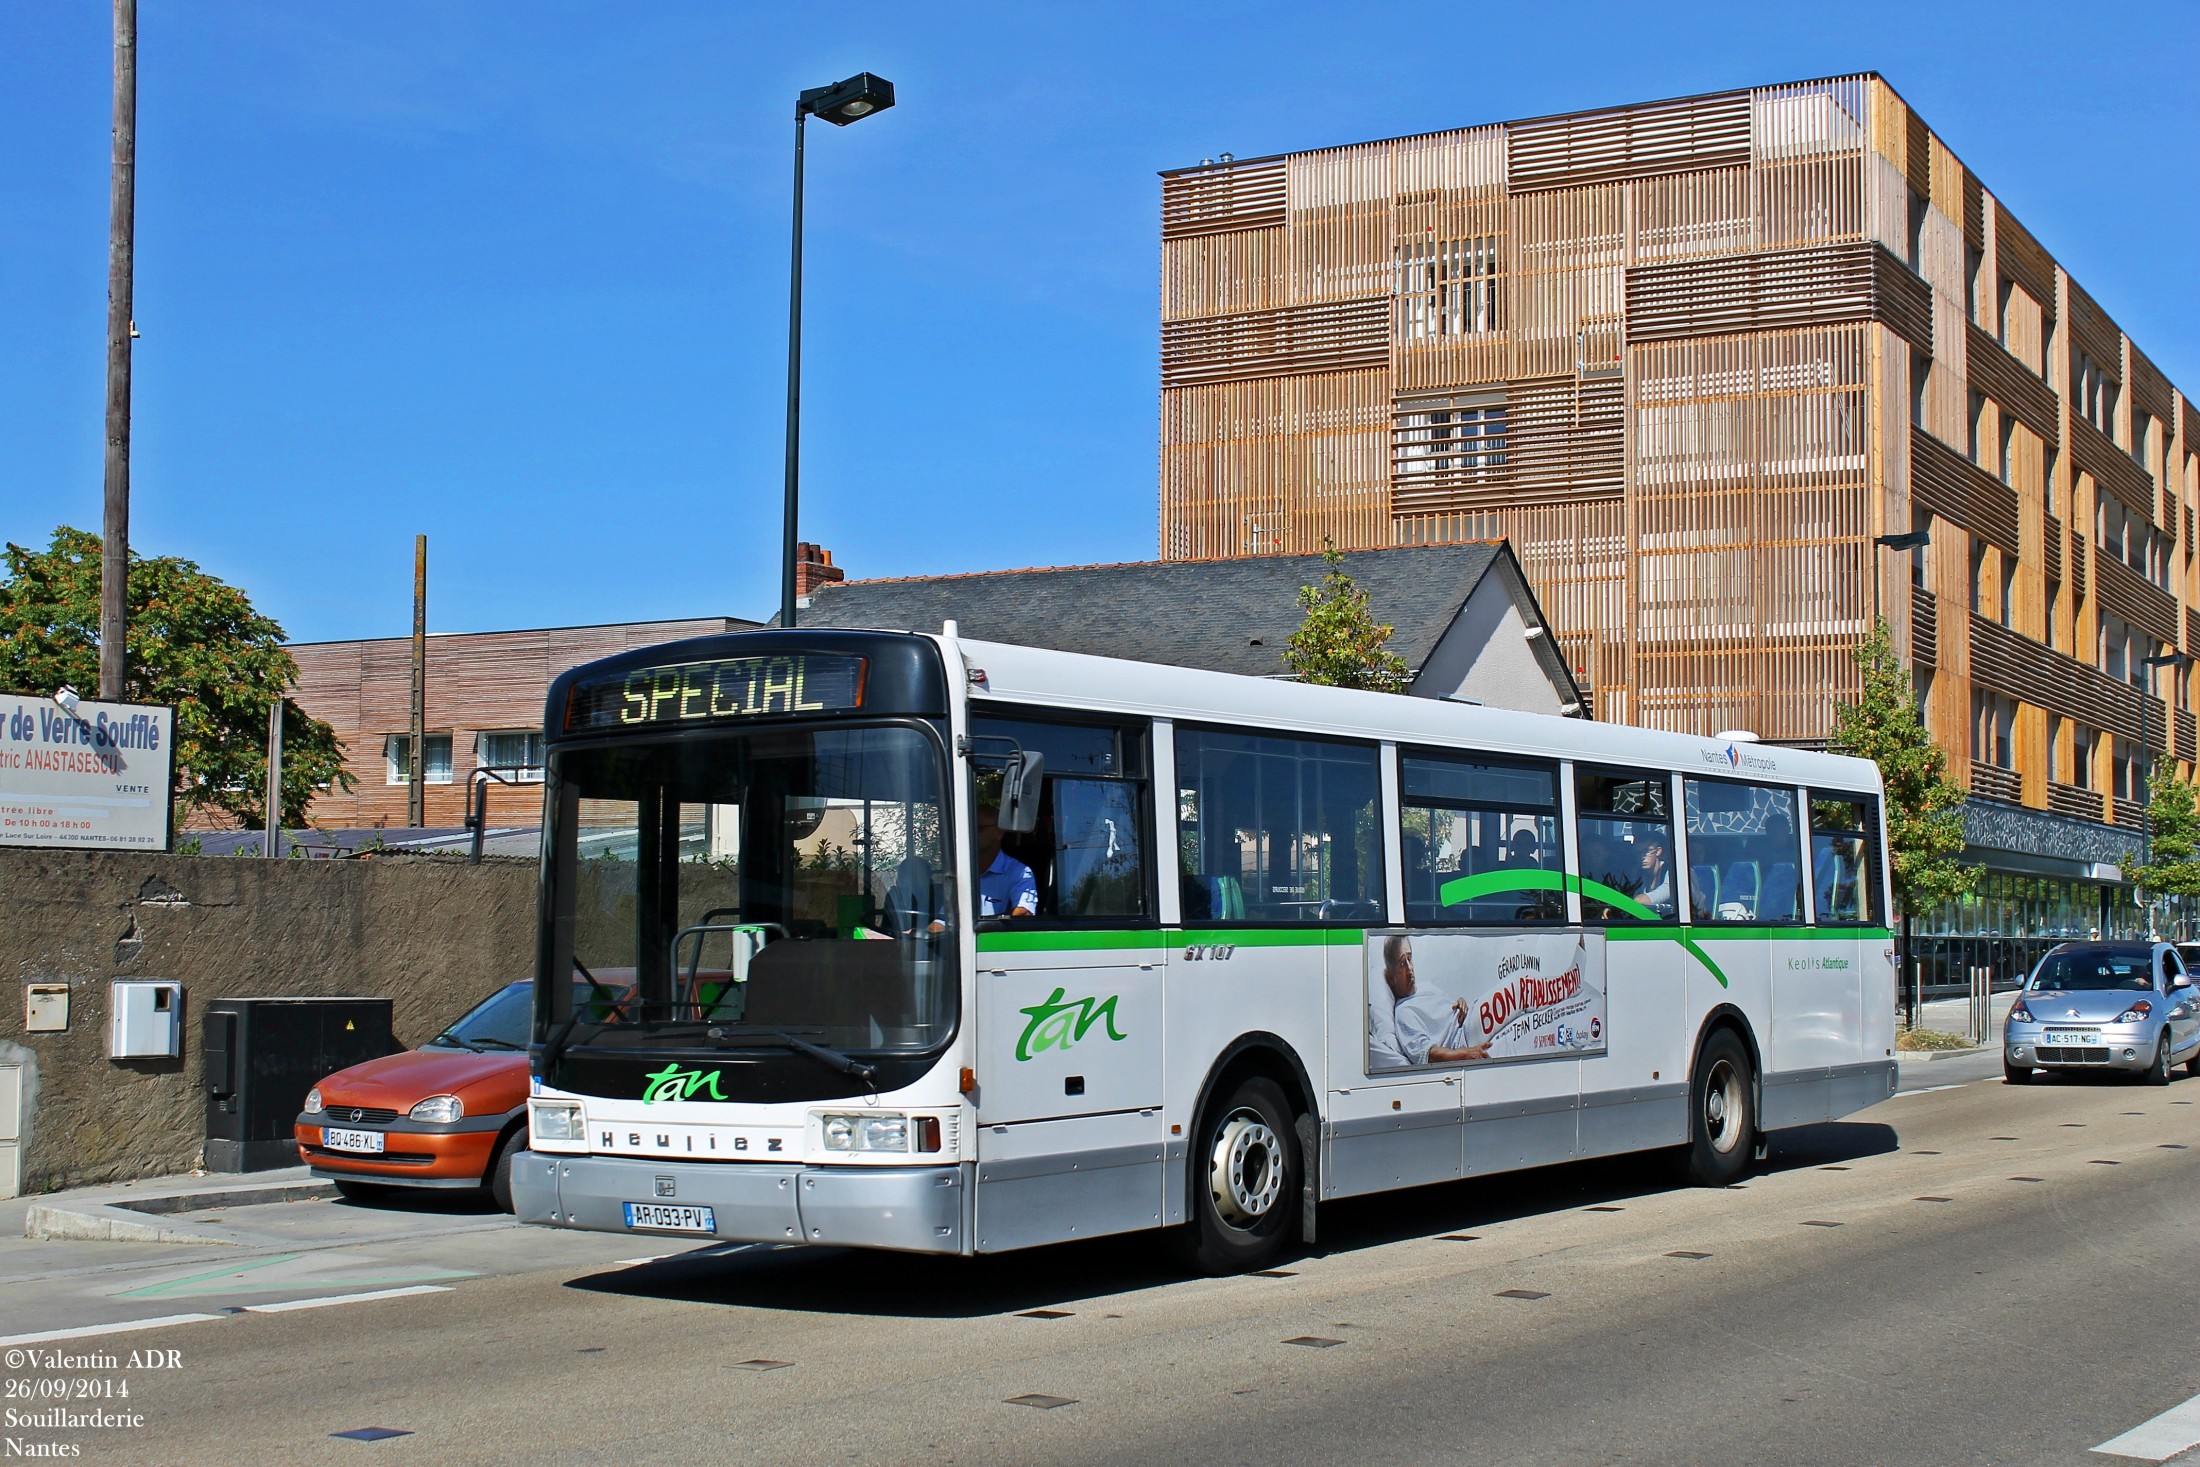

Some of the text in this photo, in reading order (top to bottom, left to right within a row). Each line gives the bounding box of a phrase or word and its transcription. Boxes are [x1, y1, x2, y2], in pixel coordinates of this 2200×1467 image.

[620, 655, 824, 724] SPECIAL
[11, 705, 34, 741] de
[40, 707, 91, 745] Verre
[95, 711, 159, 750] Soufflé
[25, 749, 118, 775] ANASTASESCU
[1700, 748, 1777, 772] Nantes Métropole
[116, 784, 150, 793] VENTE
[28, 806, 54, 815] libre
[5, 818, 16, 827] De
[19, 819, 30, 828] 10
[32, 820, 37, 828] h
[39, 820, 50, 828] 00
[60, 820, 71, 829] 18
[72, 821, 78, 829] h
[80, 821, 91, 830] 00
[5, 832, 22, 840] Luce
[23, 832, 35, 840] Sur
[36, 833, 53, 841] Loire
[1209, 943, 1236, 961] 107
[1788, 957, 1820, 970] Keolis
[1497, 954, 1520, 980] GÉRARD
[1480, 982, 1517, 1035] BON
[1015, 987, 1128, 1062] tan
[643, 1063, 728, 1104] tan
[636, 1206, 701, 1228] AR-093-PV
